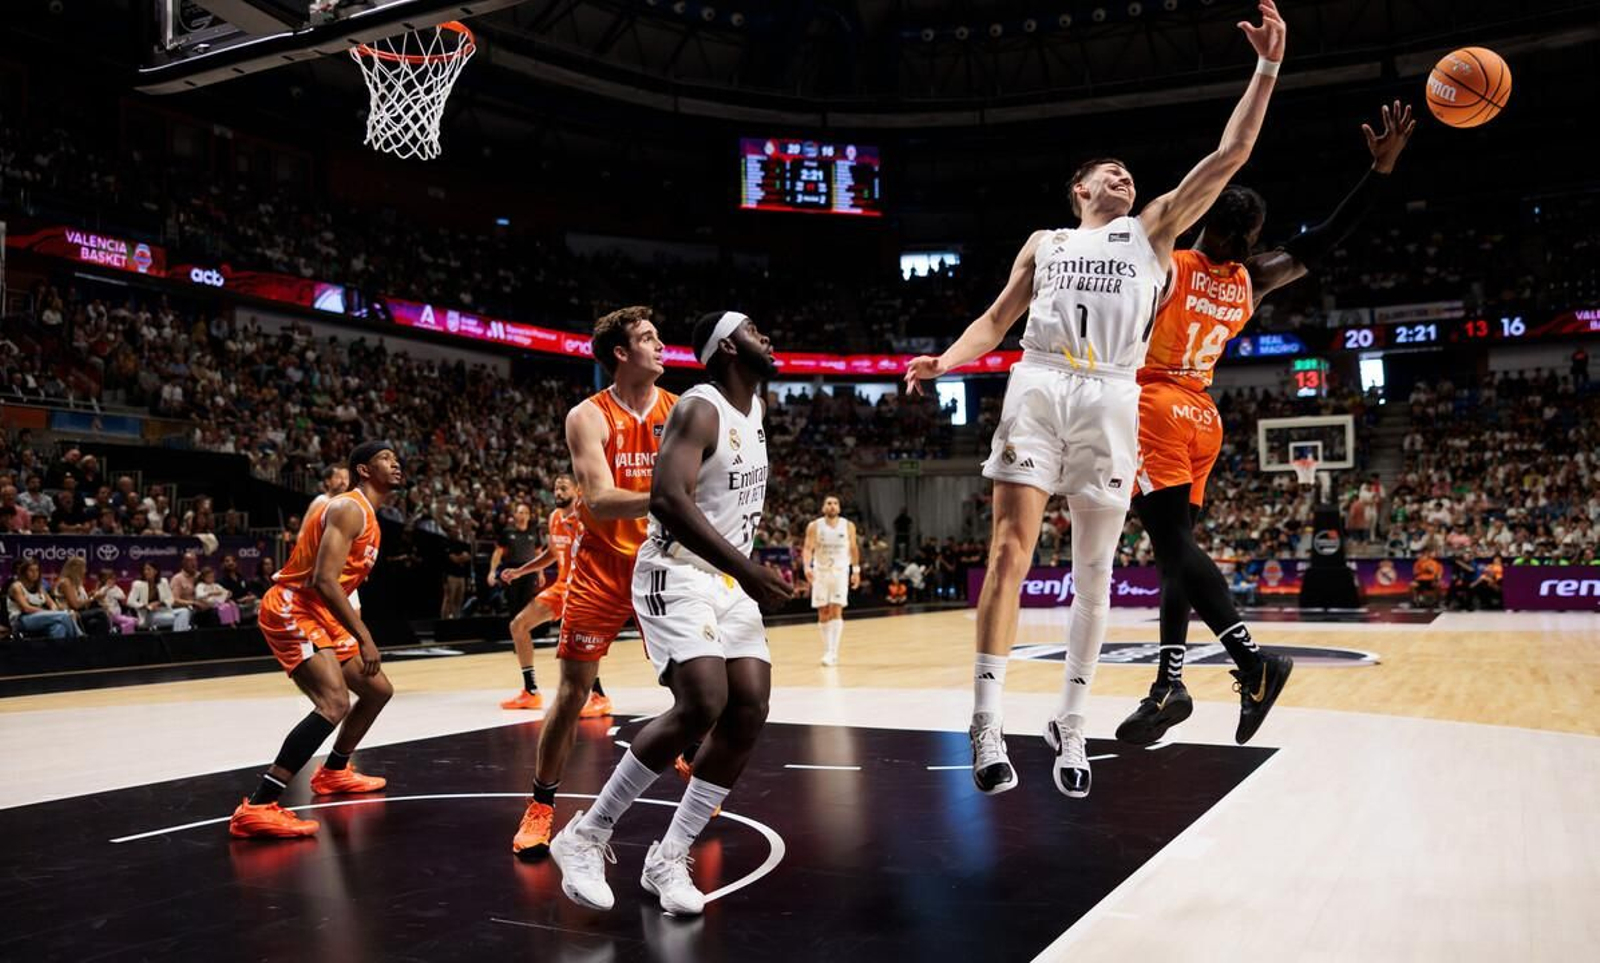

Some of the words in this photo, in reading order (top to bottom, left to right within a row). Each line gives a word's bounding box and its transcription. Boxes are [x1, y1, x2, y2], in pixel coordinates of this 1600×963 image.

[65, 228, 128, 254] VALENCIA
[80, 246, 128, 268] BASKET
[190, 267, 224, 287] acb
[1047, 256, 1137, 280] Emirates
[1076, 277, 1122, 294] BETTER
[1395, 324, 1437, 343] 2:21
[1465, 321, 1488, 337] 13
[1501, 317, 1525, 337] 16
[1345, 329, 1374, 348] 20
[1295, 371, 1319, 388] 13
[23, 545, 86, 560] endesa
[238, 547, 260, 557] acb
[1019, 572, 1075, 602] renf
[1539, 579, 1600, 596] ren
